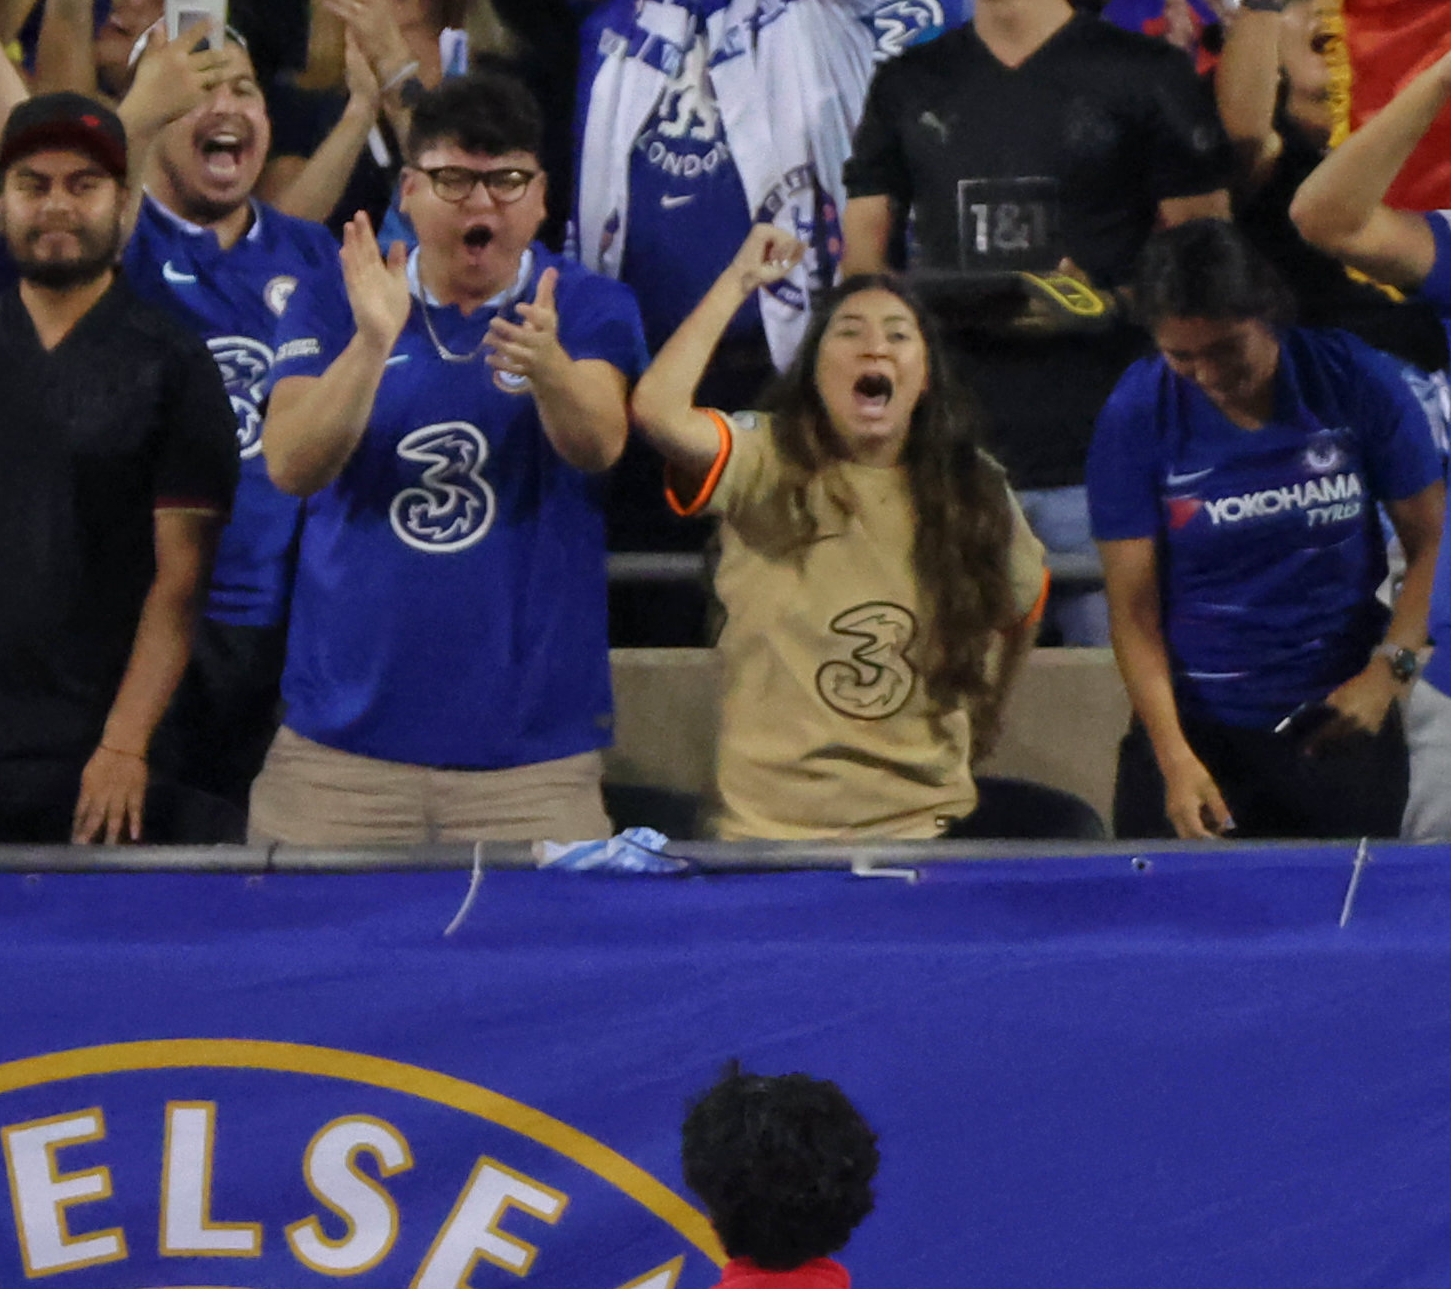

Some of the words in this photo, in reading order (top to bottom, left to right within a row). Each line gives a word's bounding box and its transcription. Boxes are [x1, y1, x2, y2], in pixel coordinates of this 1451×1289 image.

[969, 203, 1048, 254] 1&1
[390, 421, 496, 553] 3
[1204, 474, 1362, 525] YOKOHAMA
[1307, 503, 1361, 528] TYRES
[814, 599, 917, 721] 3
